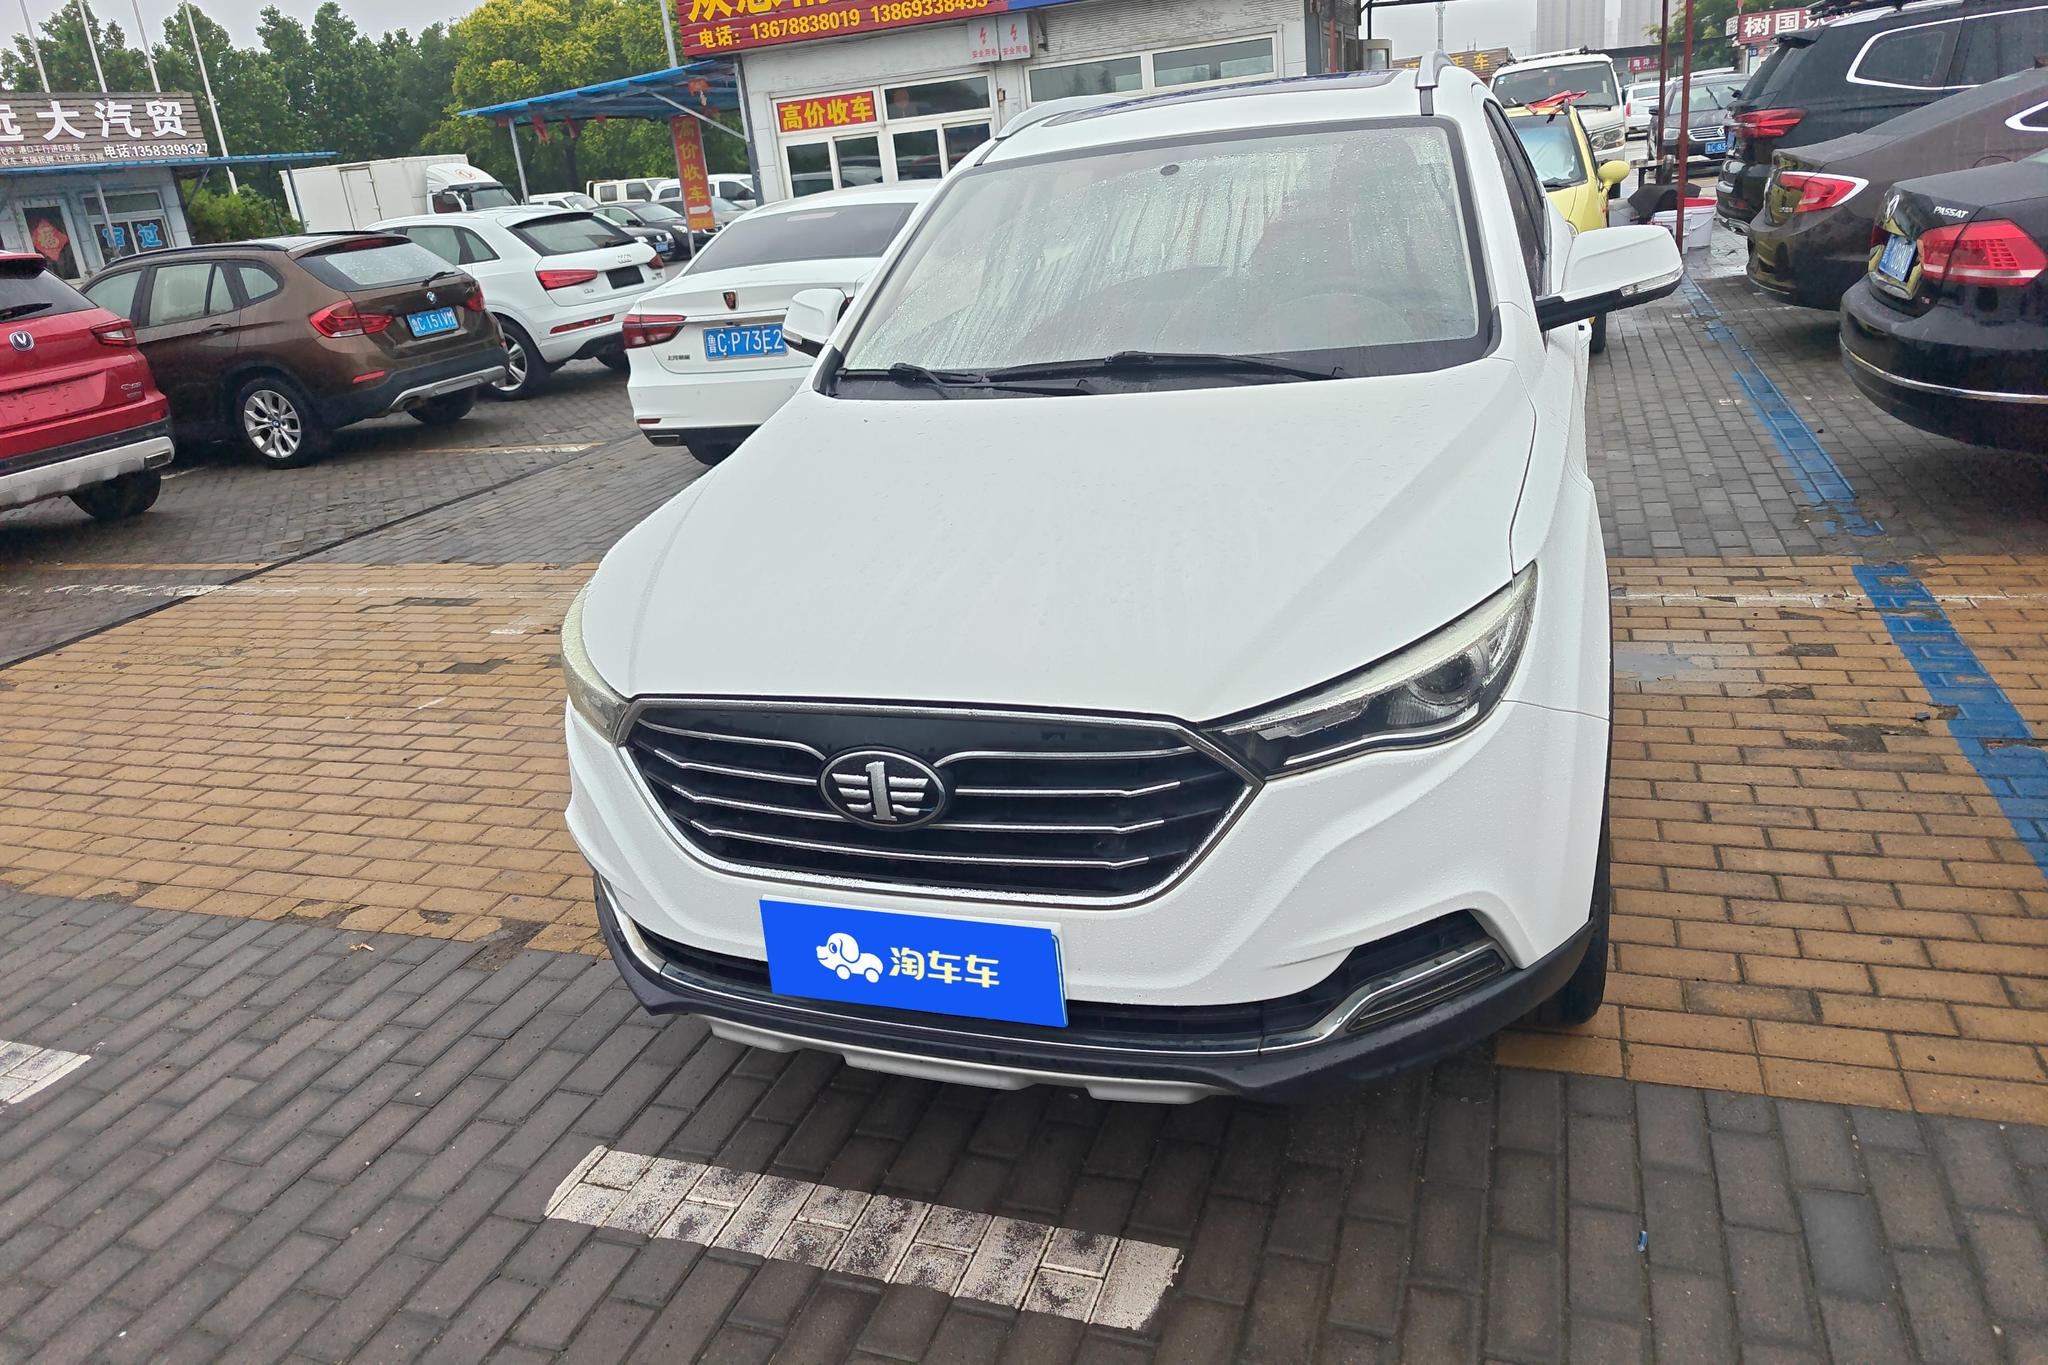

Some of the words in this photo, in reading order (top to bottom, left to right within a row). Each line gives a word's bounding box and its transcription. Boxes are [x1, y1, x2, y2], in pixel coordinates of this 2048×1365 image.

[750, 8, 861, 40] 13678838019
[0, 100, 187, 142] 远大汽贸
[780, 96, 874, 130] 高价收车
[679, 120, 706, 202] 高价收车
[1934, 206, 1969, 219] PASSAT
